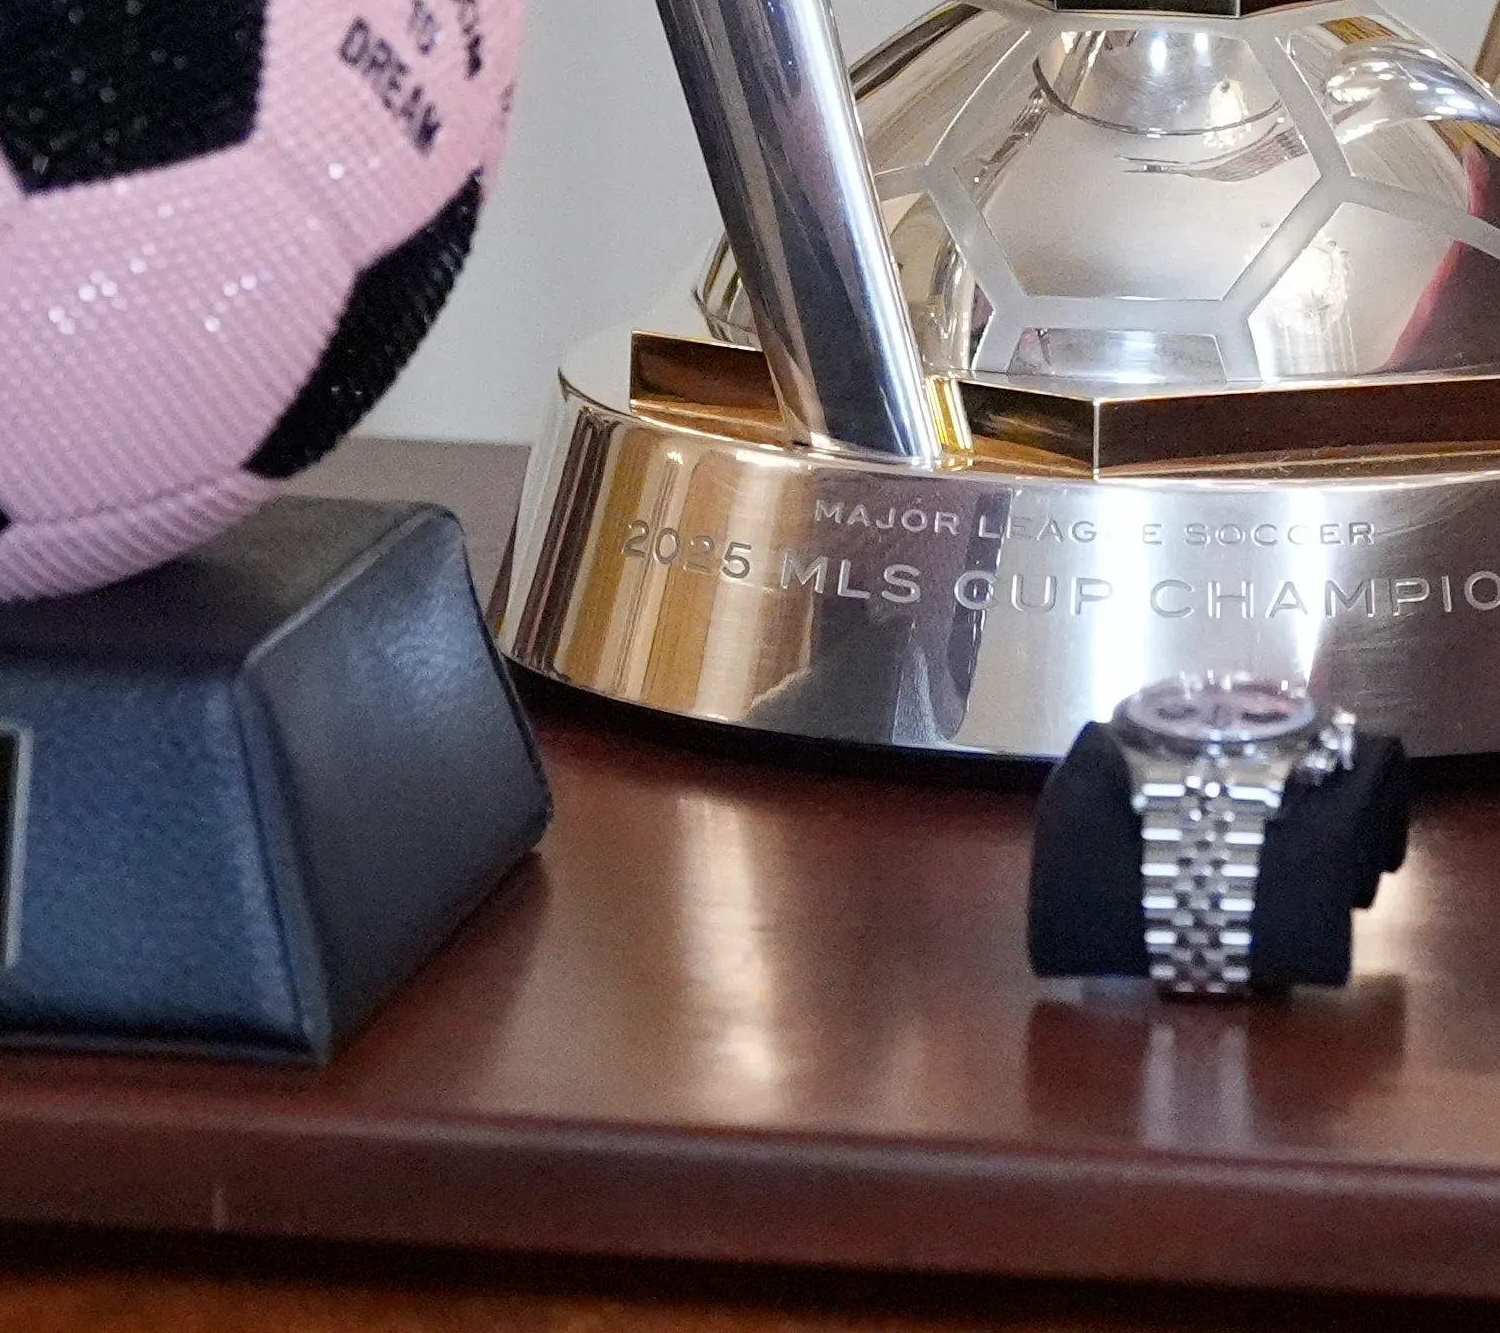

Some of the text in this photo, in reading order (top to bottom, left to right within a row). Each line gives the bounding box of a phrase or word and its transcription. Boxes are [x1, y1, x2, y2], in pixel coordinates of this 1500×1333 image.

[339, 16, 442, 158] DREAM
[621, 518, 753, 580] 2025
[779, 549, 923, 606] MLS
[953, 568, 1115, 618] CUP
[813, 498, 1377, 547] MAJOR LEAGE SOCCER
